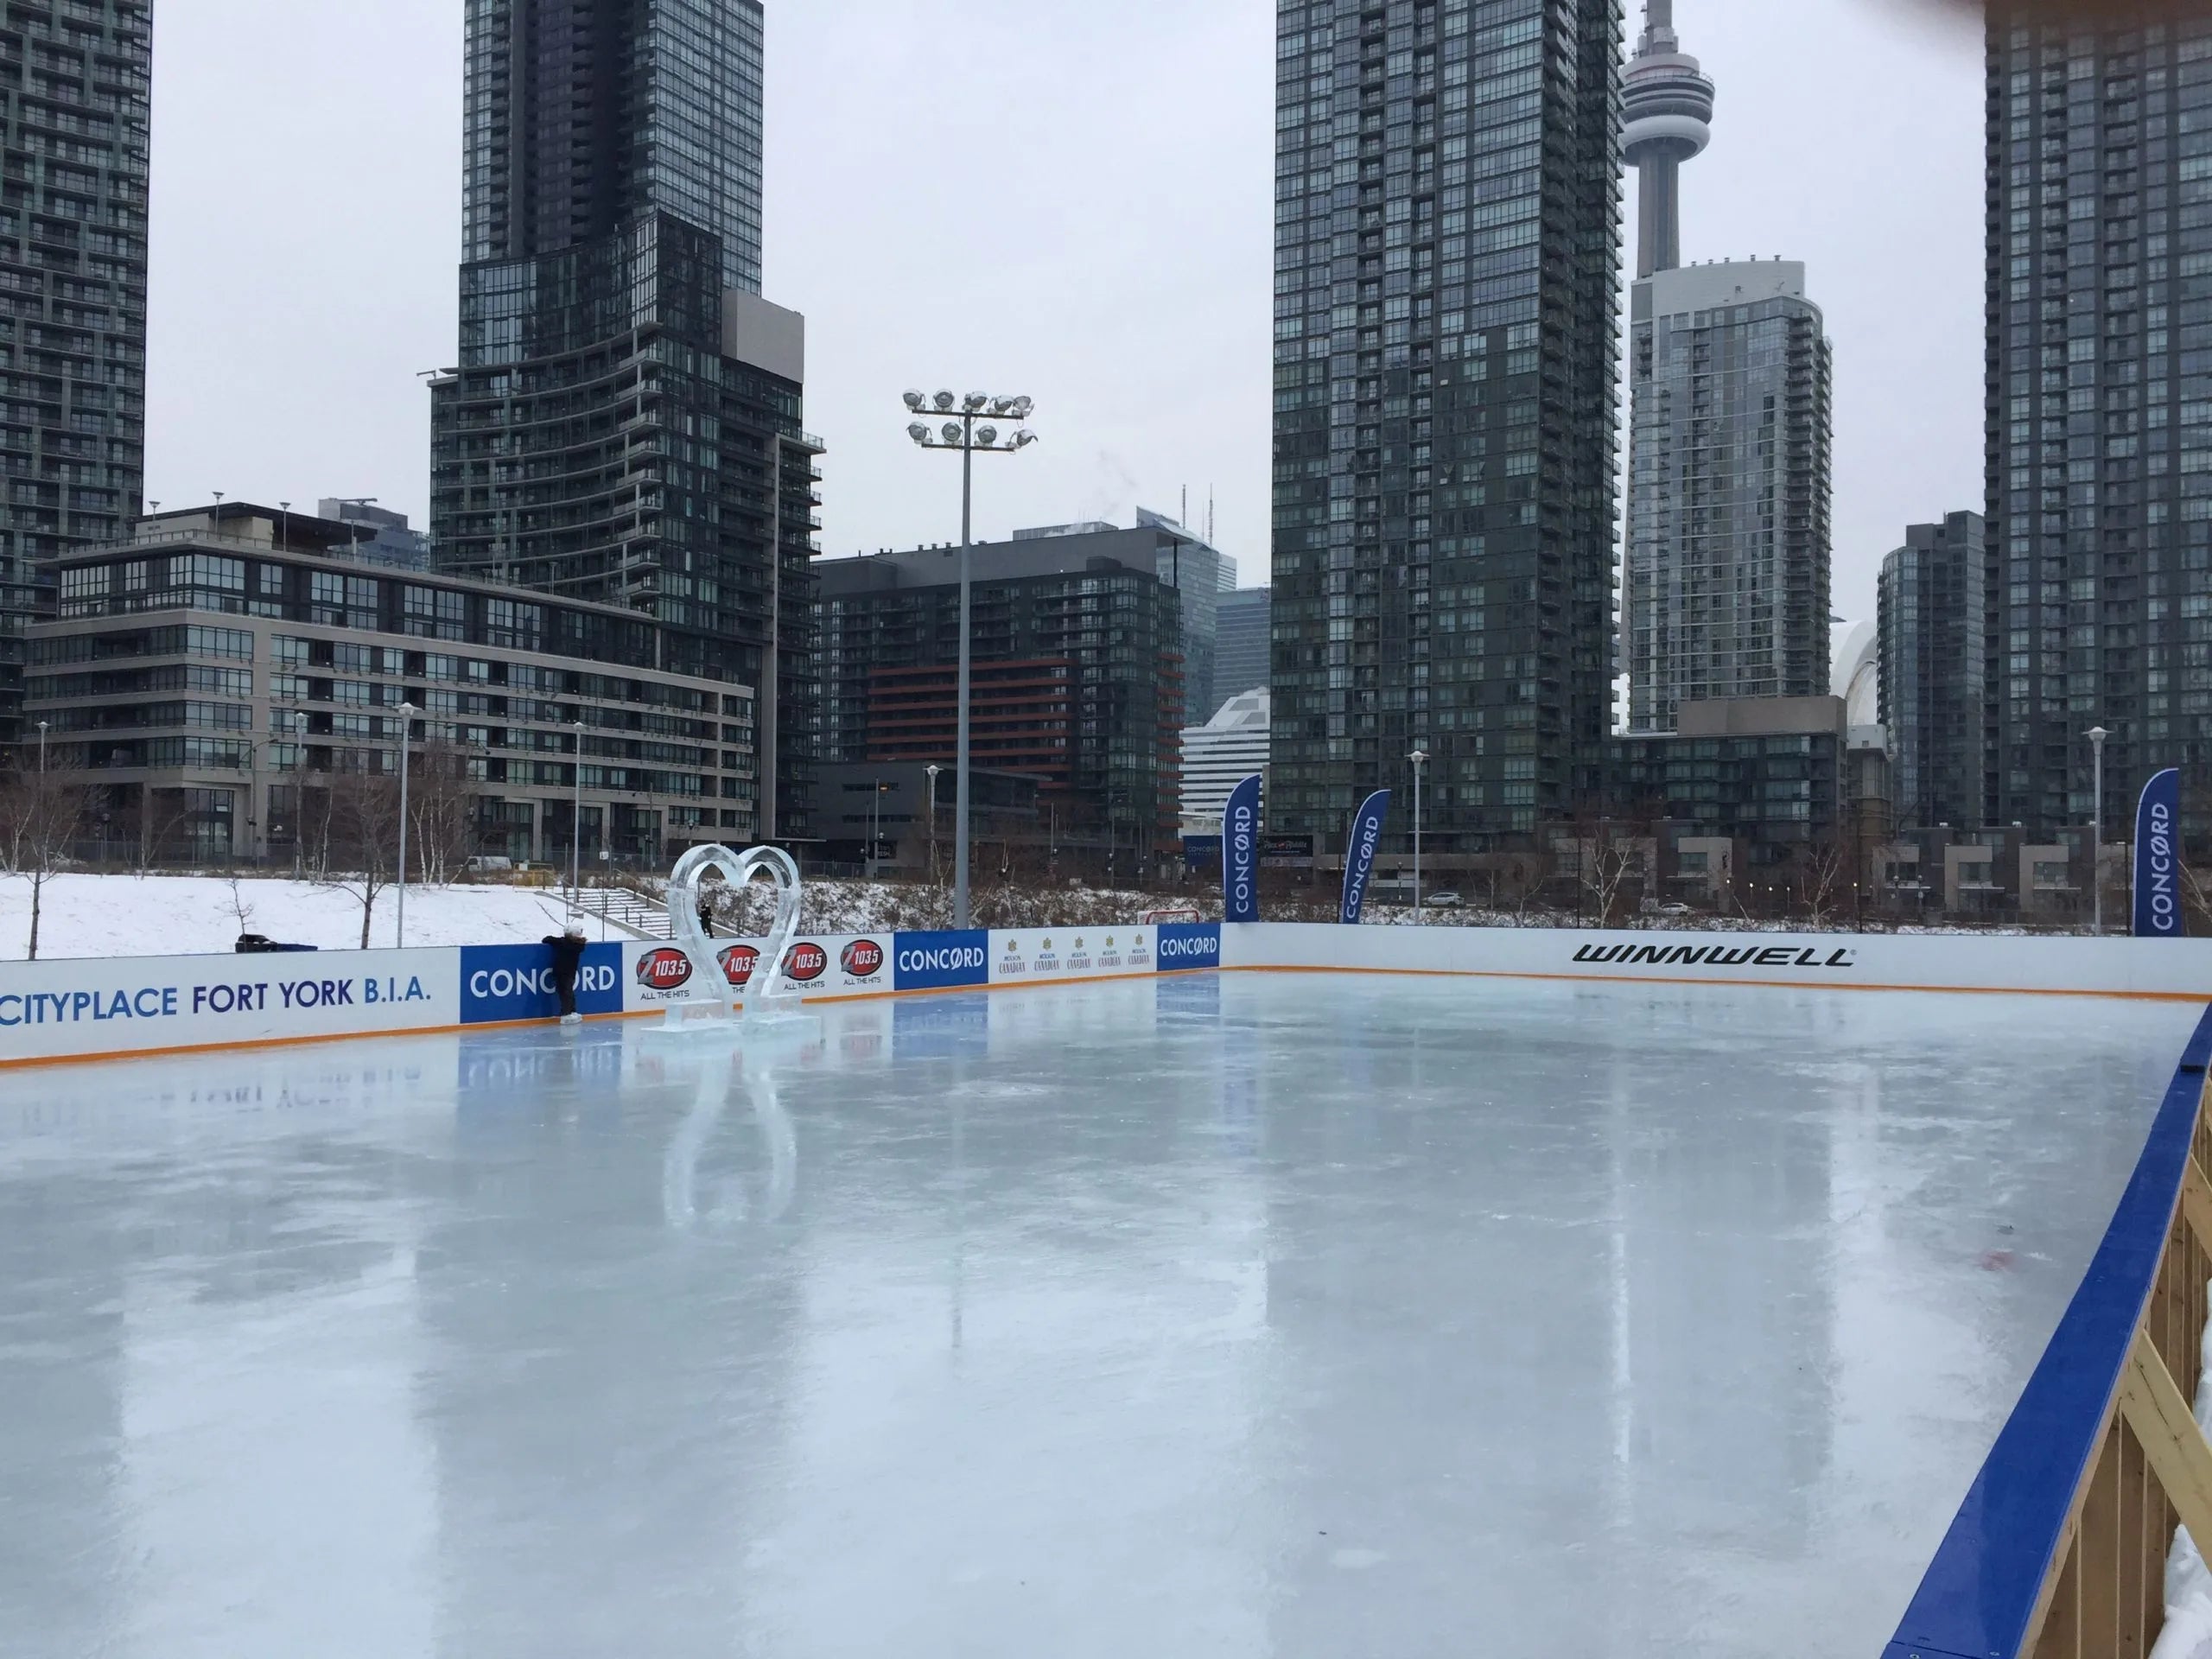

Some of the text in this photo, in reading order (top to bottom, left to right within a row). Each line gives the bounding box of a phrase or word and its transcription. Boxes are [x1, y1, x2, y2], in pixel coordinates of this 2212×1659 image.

[1572, 944, 1854, 968] WINNWELL
[0, 976, 431, 1026] CITYPLACE FORT YORK B.I.A.
[672, 989, 690, 998] HITS
